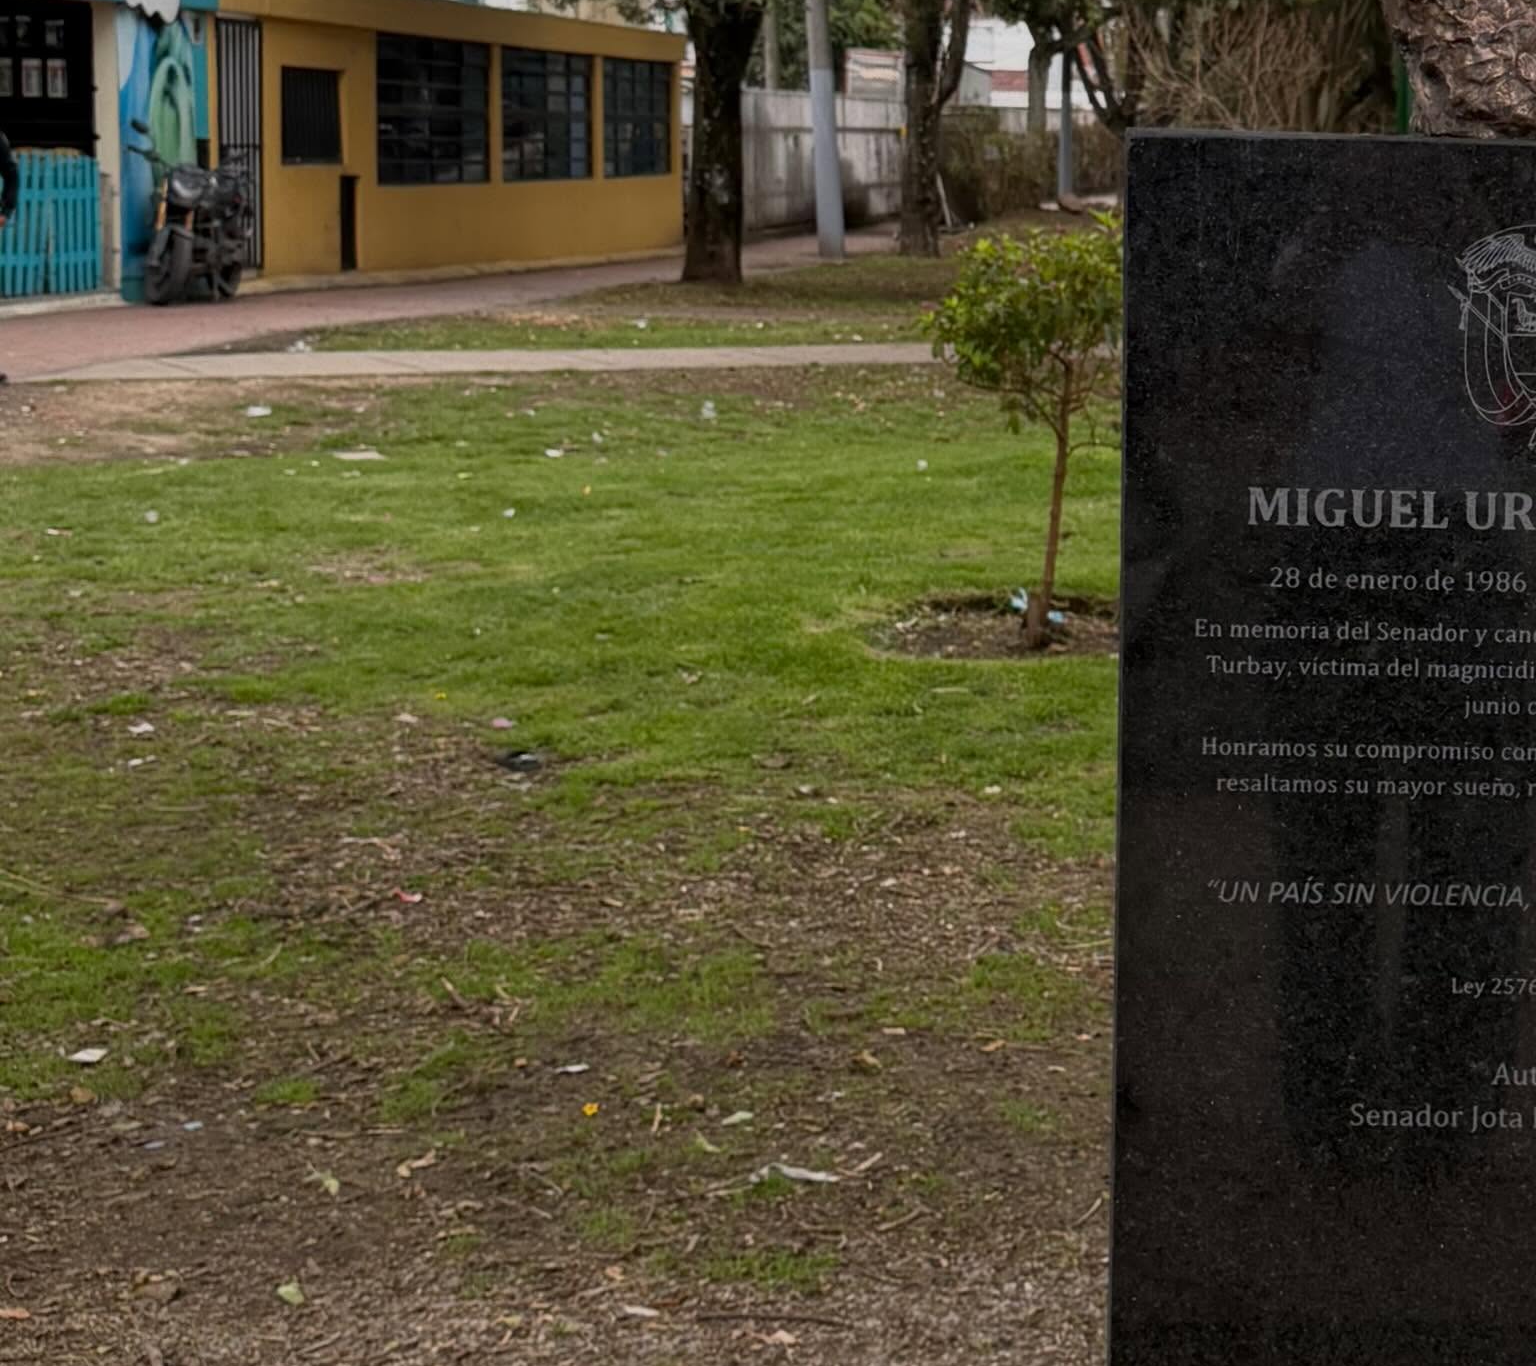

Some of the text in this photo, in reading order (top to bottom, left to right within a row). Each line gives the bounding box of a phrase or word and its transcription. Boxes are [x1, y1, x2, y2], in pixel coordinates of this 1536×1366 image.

[1247, 486, 1450, 530] MIGUEL
[1270, 566, 1301, 588] 28
[1308, 568, 1337, 589] de
[1346, 572, 1418, 591] enero
[1425, 569, 1455, 593] de
[1464, 571, 1527, 593] 1986
[1194, 619, 1222, 638] En
[1229, 619, 1330, 640] memoria
[1336, 621, 1370, 641] del
[1377, 622, 1469, 642] Senador
[1474, 628, 1488, 647] y
[1206, 655, 1292, 680] Turbay,
[1299, 657, 1380, 677] víctima
[1387, 658, 1419, 678] del
[1464, 695, 1520, 719] junio
[1201, 737, 1317, 758] Honramos
[1324, 743, 1348, 758] su
[1355, 742, 1494, 763] compromiso
[1216, 774, 1337, 794] resaltamos
[1344, 780, 1369, 794] su
[1377, 780, 1447, 800] mayor
[1453, 778, 1520, 799] sueño,
[1268, 876, 1325, 905] PAÍS
[1332, 882, 1375, 905] SIN
[1385, 883, 1530, 911] VIOLENCIA,
[1452, 978, 1485, 998] Ley
[1350, 1104, 1463, 1129] Senador
[1472, 1106, 1523, 1132] Jota
